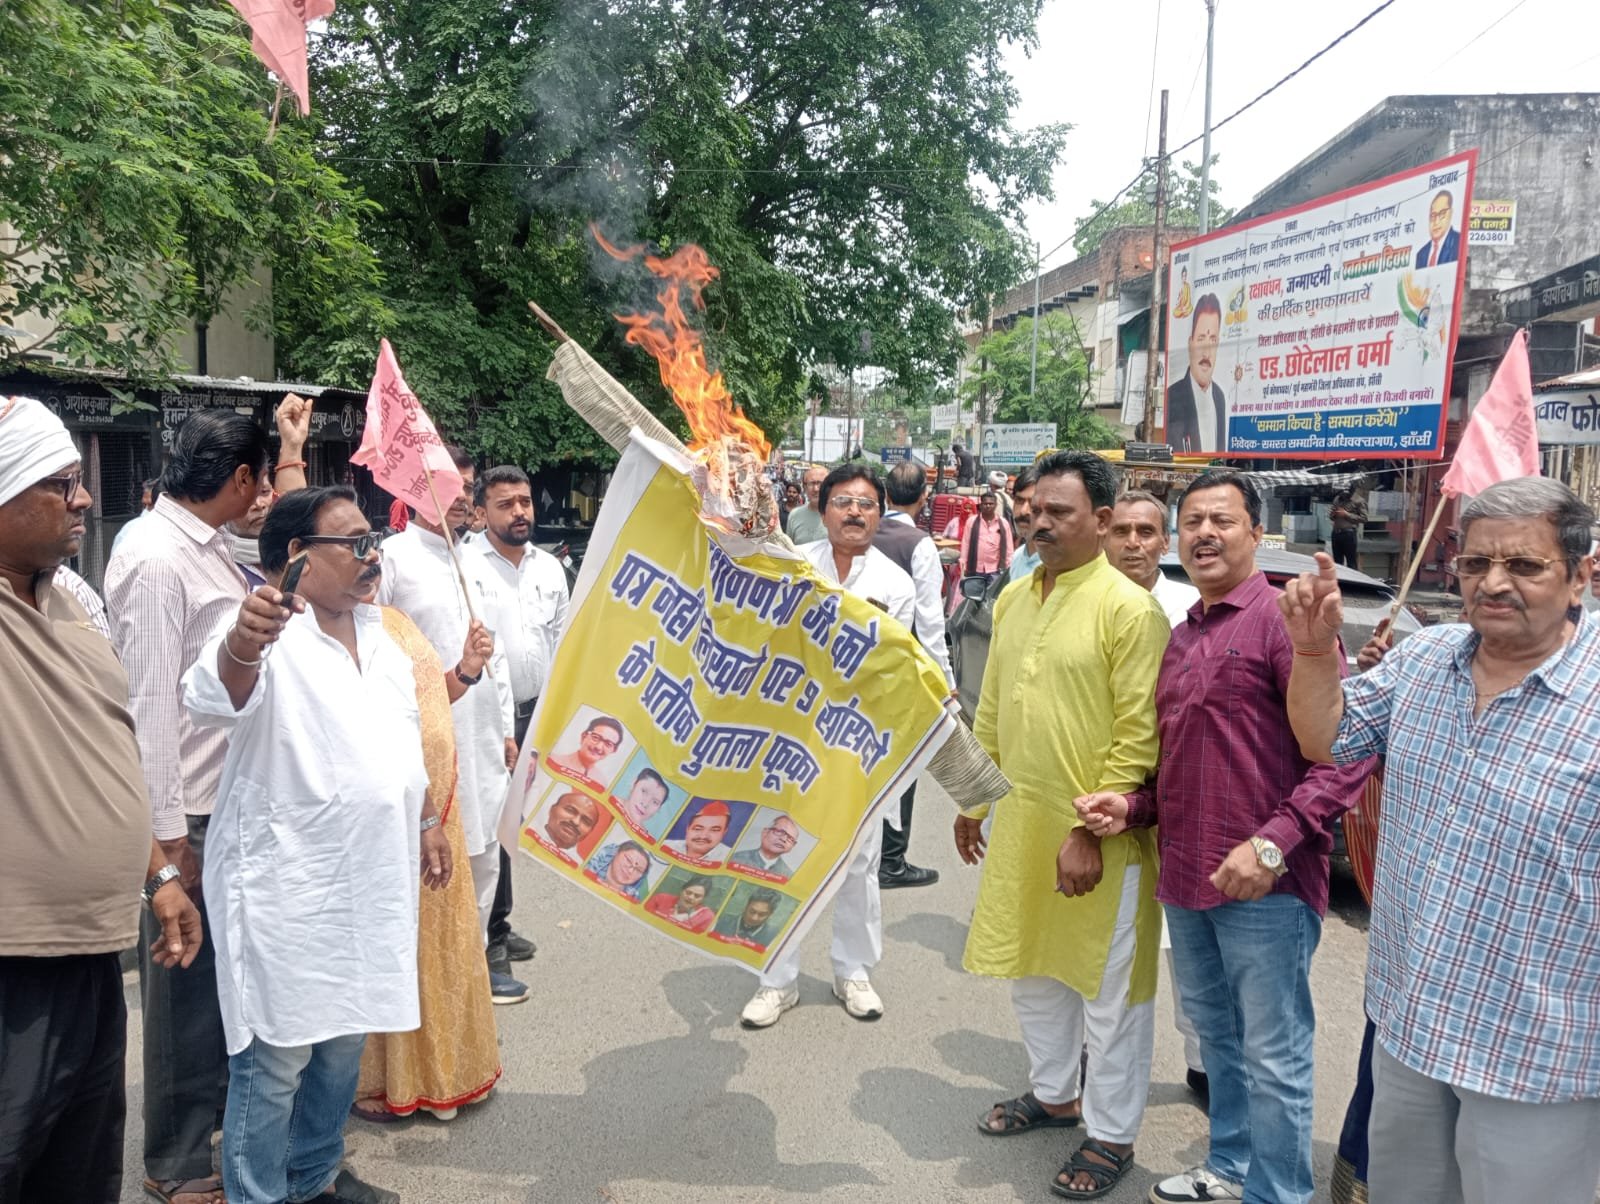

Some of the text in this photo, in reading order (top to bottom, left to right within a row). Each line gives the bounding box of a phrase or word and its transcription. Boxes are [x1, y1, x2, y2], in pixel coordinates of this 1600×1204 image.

[1294, 243, 1326, 261] नगरवासी
[1343, 234, 1370, 250] पत्रकार
[1404, 218, 1416, 234] को
[1470, 232, 1508, 241] 2263801
[1286, 263, 1332, 294] जन्माष्टमी
[1381, 245, 1412, 273] दिवस
[1258, 282, 1373, 321] की हार्दिक शुभकामनायें
[1258, 334, 1272, 347] जिला
[1333, 318, 1355, 335] महामंत्री
[1357, 319, 1367, 331] पद
[1368, 315, 1374, 330] के
[1375, 310, 1400, 328] प्रत्याशी
[1357, 330, 1394, 368] वर्मा
[1329, 395, 1343, 406] देकर
[1344, 393, 1358, 405] भारी
[1360, 391, 1374, 404] मतों
[1375, 392, 1382, 403] से
[1384, 389, 1408, 402] विजयी
[1571, 394, 1600, 431] फो
[1262, 439, 1286, 449] समस्त
[1288, 434, 1325, 448] सम्मानित
[1287, 414, 1312, 431] किया
[1328, 415, 1363, 429] सम्मान
[611, 553, 667, 606] पत्र
[760, 657, 805, 702] पर
[831, 621, 877, 680] को
[618, 640, 820, 793] के प्रतीक पुतला फूका
